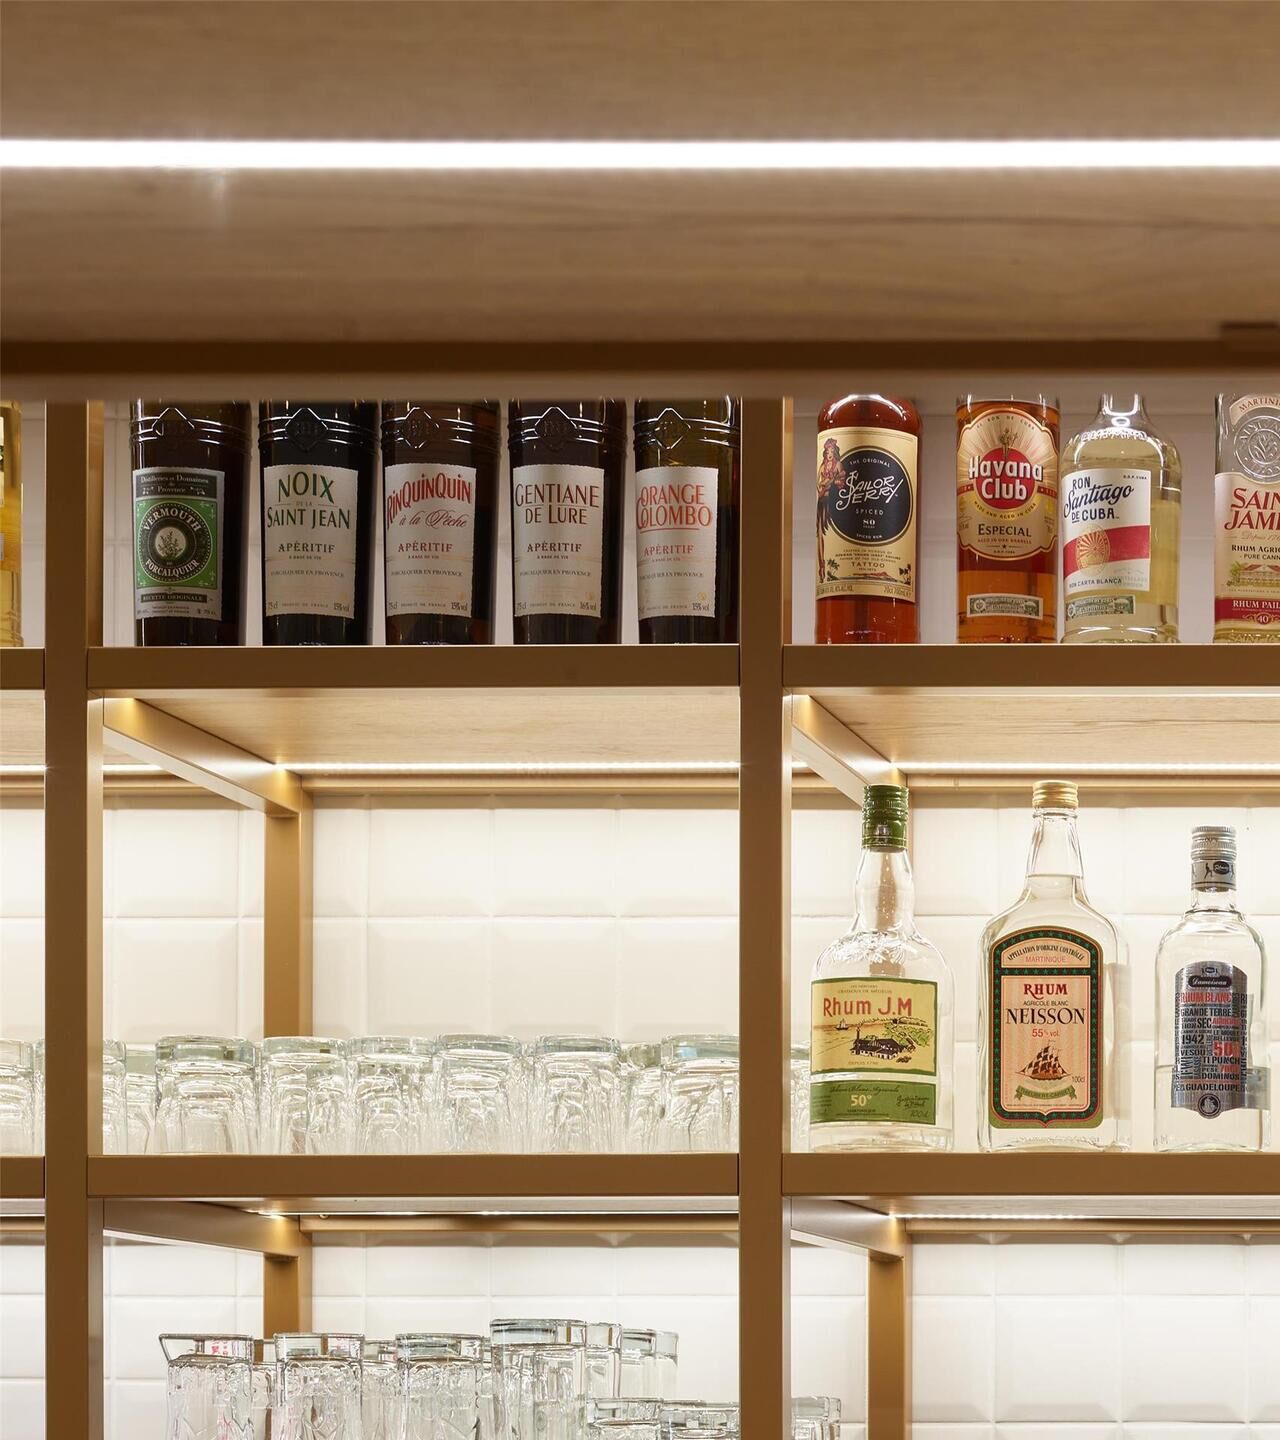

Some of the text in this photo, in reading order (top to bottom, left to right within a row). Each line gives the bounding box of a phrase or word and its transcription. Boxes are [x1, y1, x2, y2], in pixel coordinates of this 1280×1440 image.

[968, 456, 1045, 486] Havana
[277, 471, 335, 504] NOIX
[845, 469, 895, 496] SAILOR
[980, 480, 1028, 502] Club
[1071, 476, 1091, 490] RON
[515, 483, 600, 508] GENTIANE
[640, 484, 705, 508] ORANGE
[835, 475, 905, 511] JERRY
[1063, 484, 1135, 519] Santiago
[143, 506, 202, 532] VERMOUTH
[266, 507, 352, 532] SAINT JEAN
[425, 508, 470, 530] Pêche
[525, 505, 588, 525] DE LURE
[636, 497, 713, 530] COLOMBO
[855, 508, 885, 517] SPICED
[1090, 507, 1116, 520] CUBA
[977, 524, 1032, 538] ESPECIAL
[277, 540, 336, 554] APÉRITIF
[397, 540, 453, 553] APÉRITIF
[526, 540, 583, 553] APÉRITIF
[643, 543, 695, 556] APÉRITIF
[1231, 544, 1255, 554] RHUM
[144, 558, 200, 578] FORCALQUIER
[851, 561, 886, 569] TATTOO
[1231, 600, 1258, 610] RHUM
[1256, 616, 1269, 625] 40
[1025, 955, 1066, 963] MARTINIQUE
[1023, 983, 1068, 1001] RHUM
[823, 996, 913, 1018] Rhum J.M
[1006, 1007, 1085, 1025] NEISSON
[1180, 1007, 1233, 1017] GRANDE TERRE
[1196, 1017, 1213, 1030] SEC
[1181, 1034, 1205, 1045] 1942
